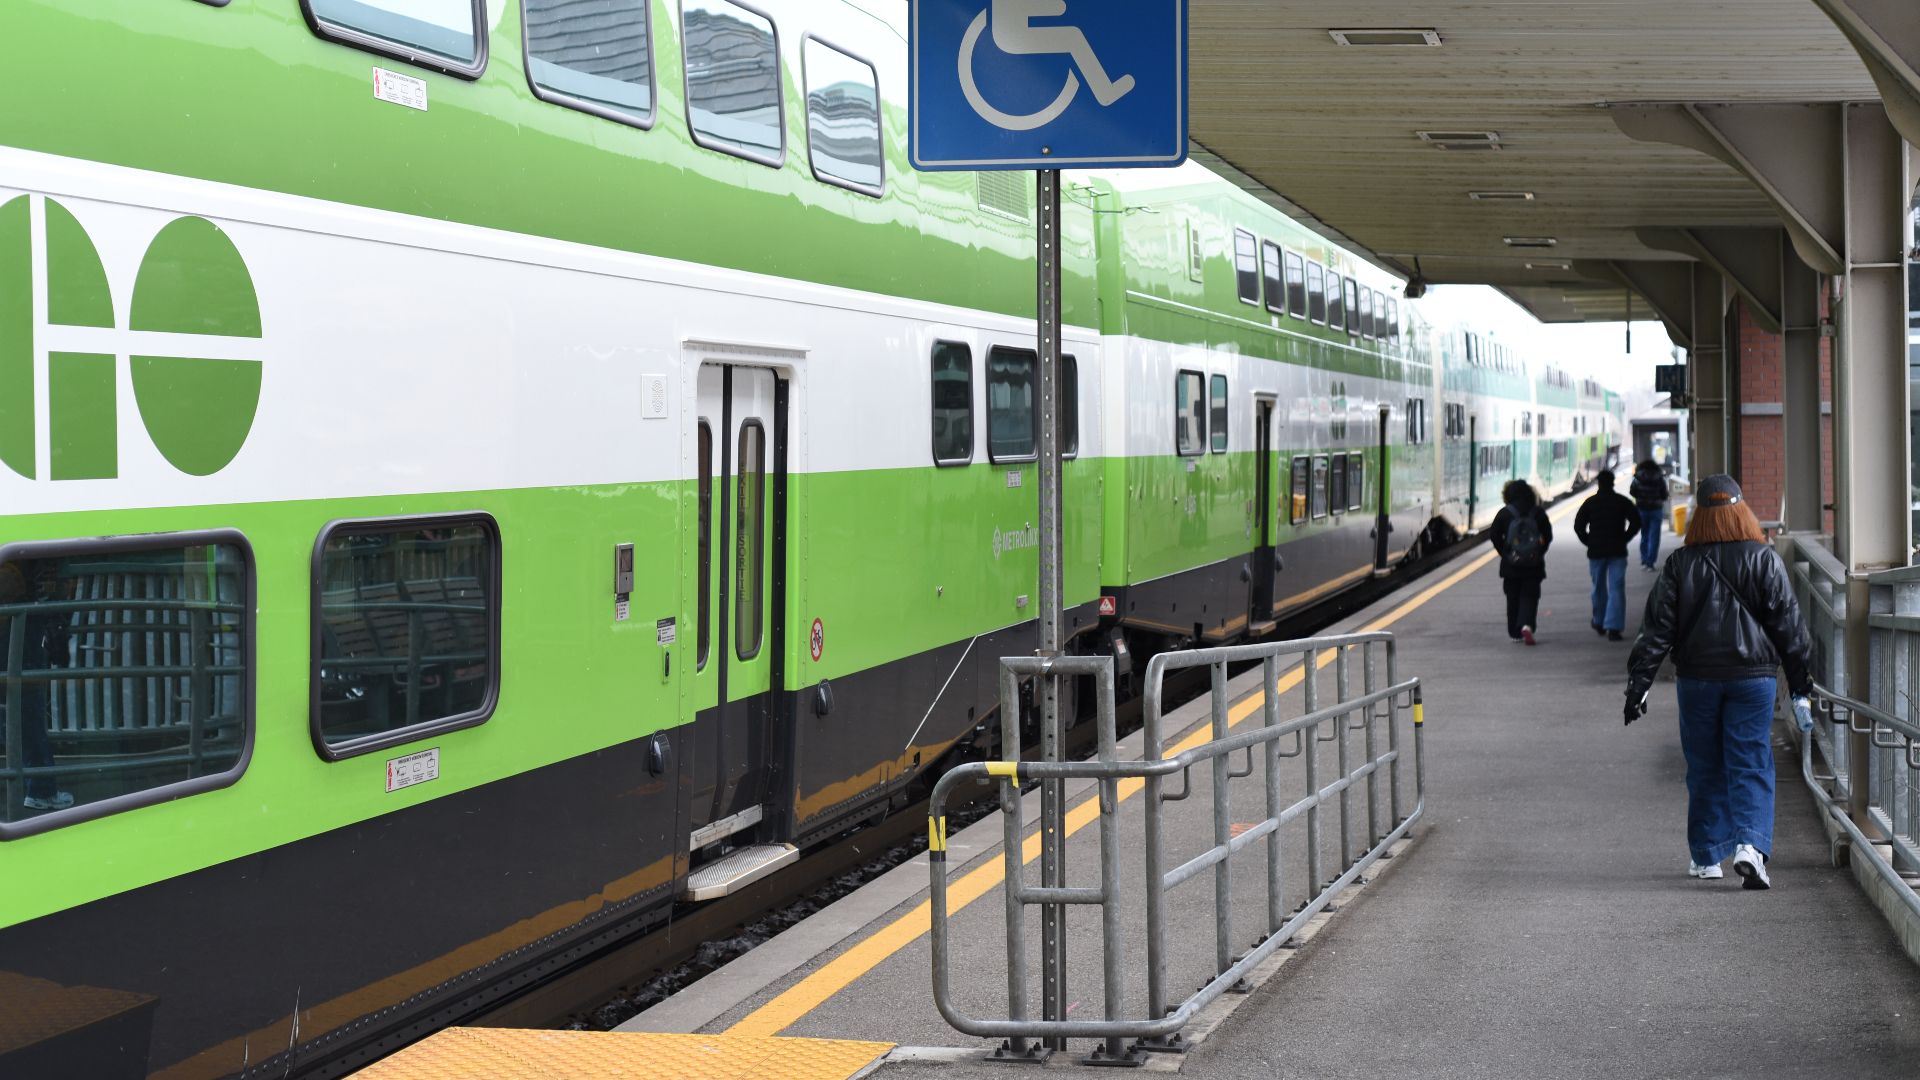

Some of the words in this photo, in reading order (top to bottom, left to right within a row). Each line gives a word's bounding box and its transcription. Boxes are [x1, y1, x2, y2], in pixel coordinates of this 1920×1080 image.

[0, 194, 262, 480] GO
[738, 536, 746, 600] SORTIE
[1002, 528, 1038, 552] METROLINX
